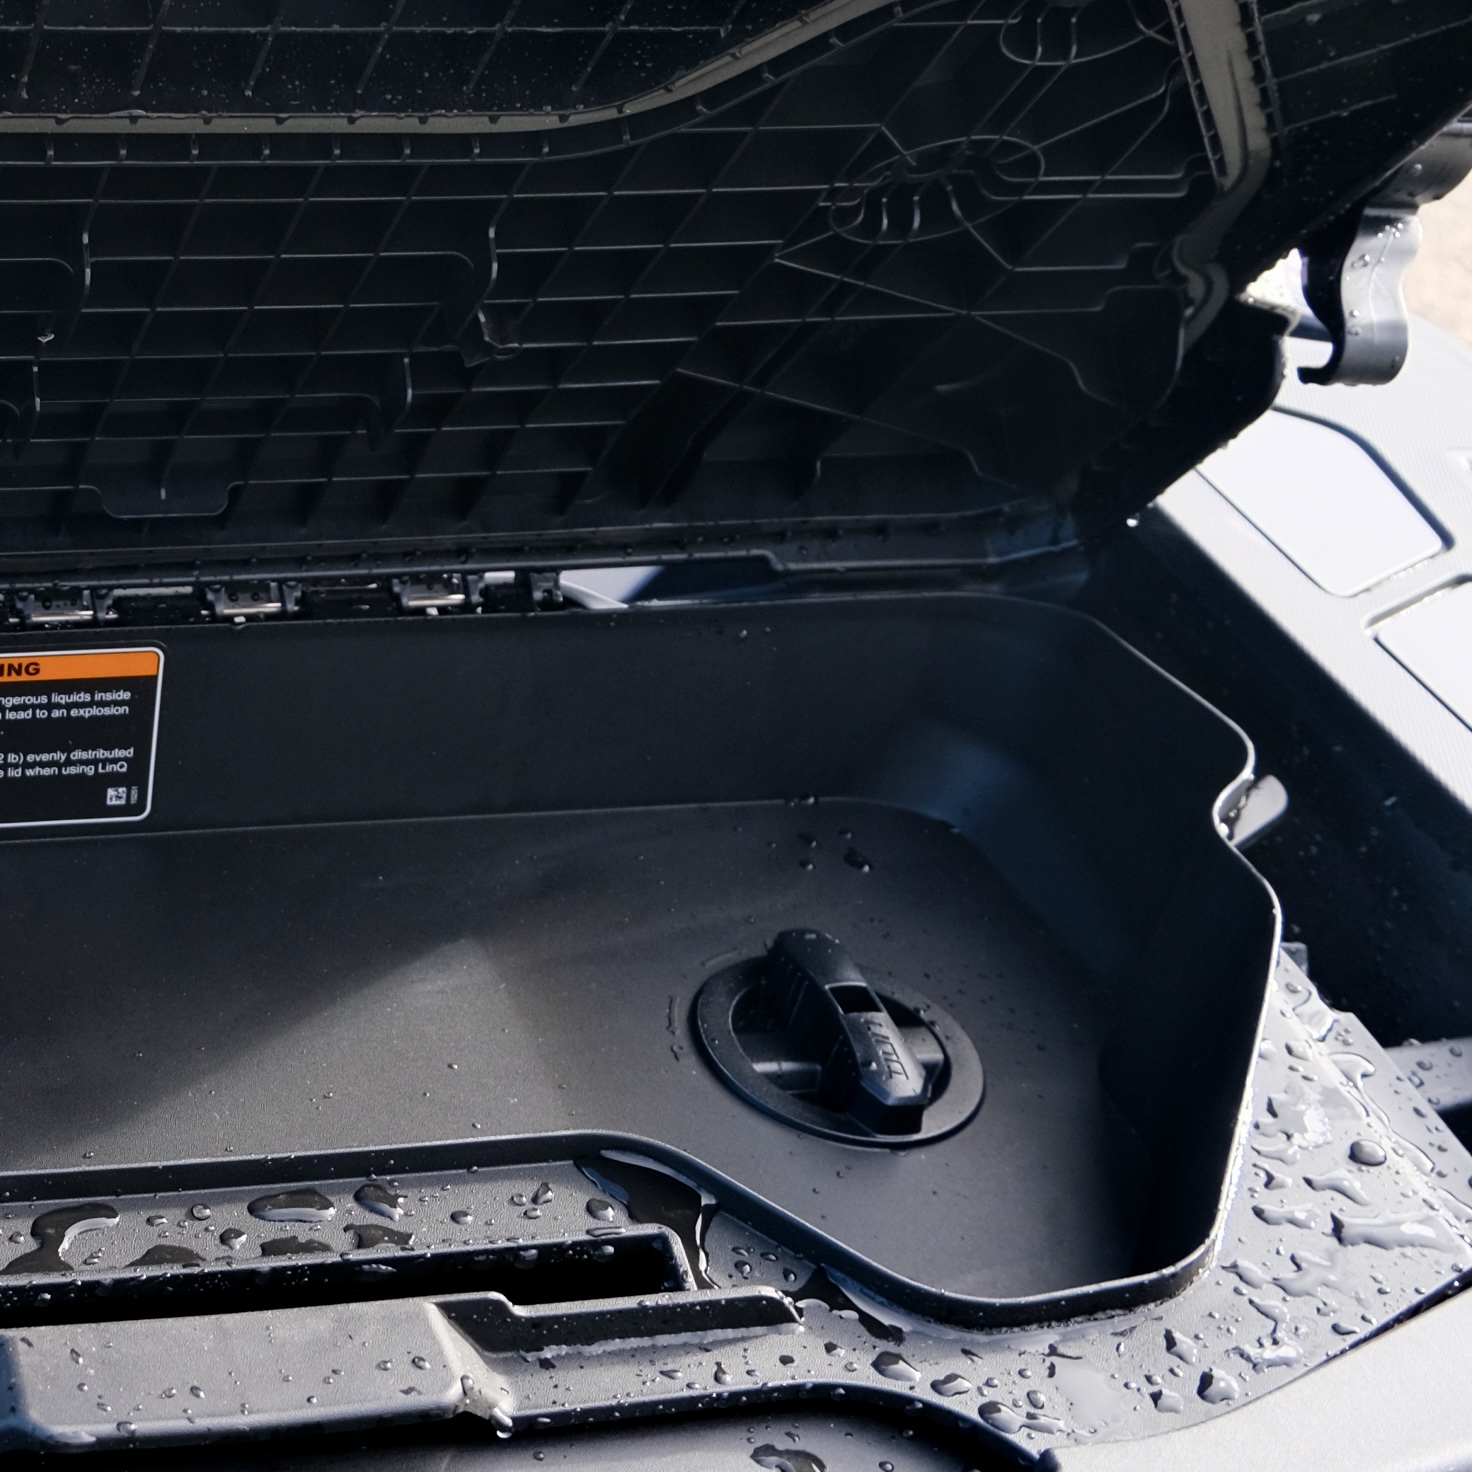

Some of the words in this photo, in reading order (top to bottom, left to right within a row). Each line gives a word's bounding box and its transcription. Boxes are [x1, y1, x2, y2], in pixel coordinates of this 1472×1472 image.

[52, 692, 91, 704] liquids
[95, 690, 131, 701] inside
[6, 709, 32, 720] lead
[36, 708, 48, 718] to
[51, 708, 66, 717] an
[70, 705, 129, 719] explosion
[8, 752, 24, 764] lb)
[27, 751, 67, 763] evenly
[70, 747, 134, 760] distributed
[8, 767, 21, 777] lid
[26, 765, 58, 776] when
[62, 764, 94, 775] using
[98, 761, 127, 773] LinQ
